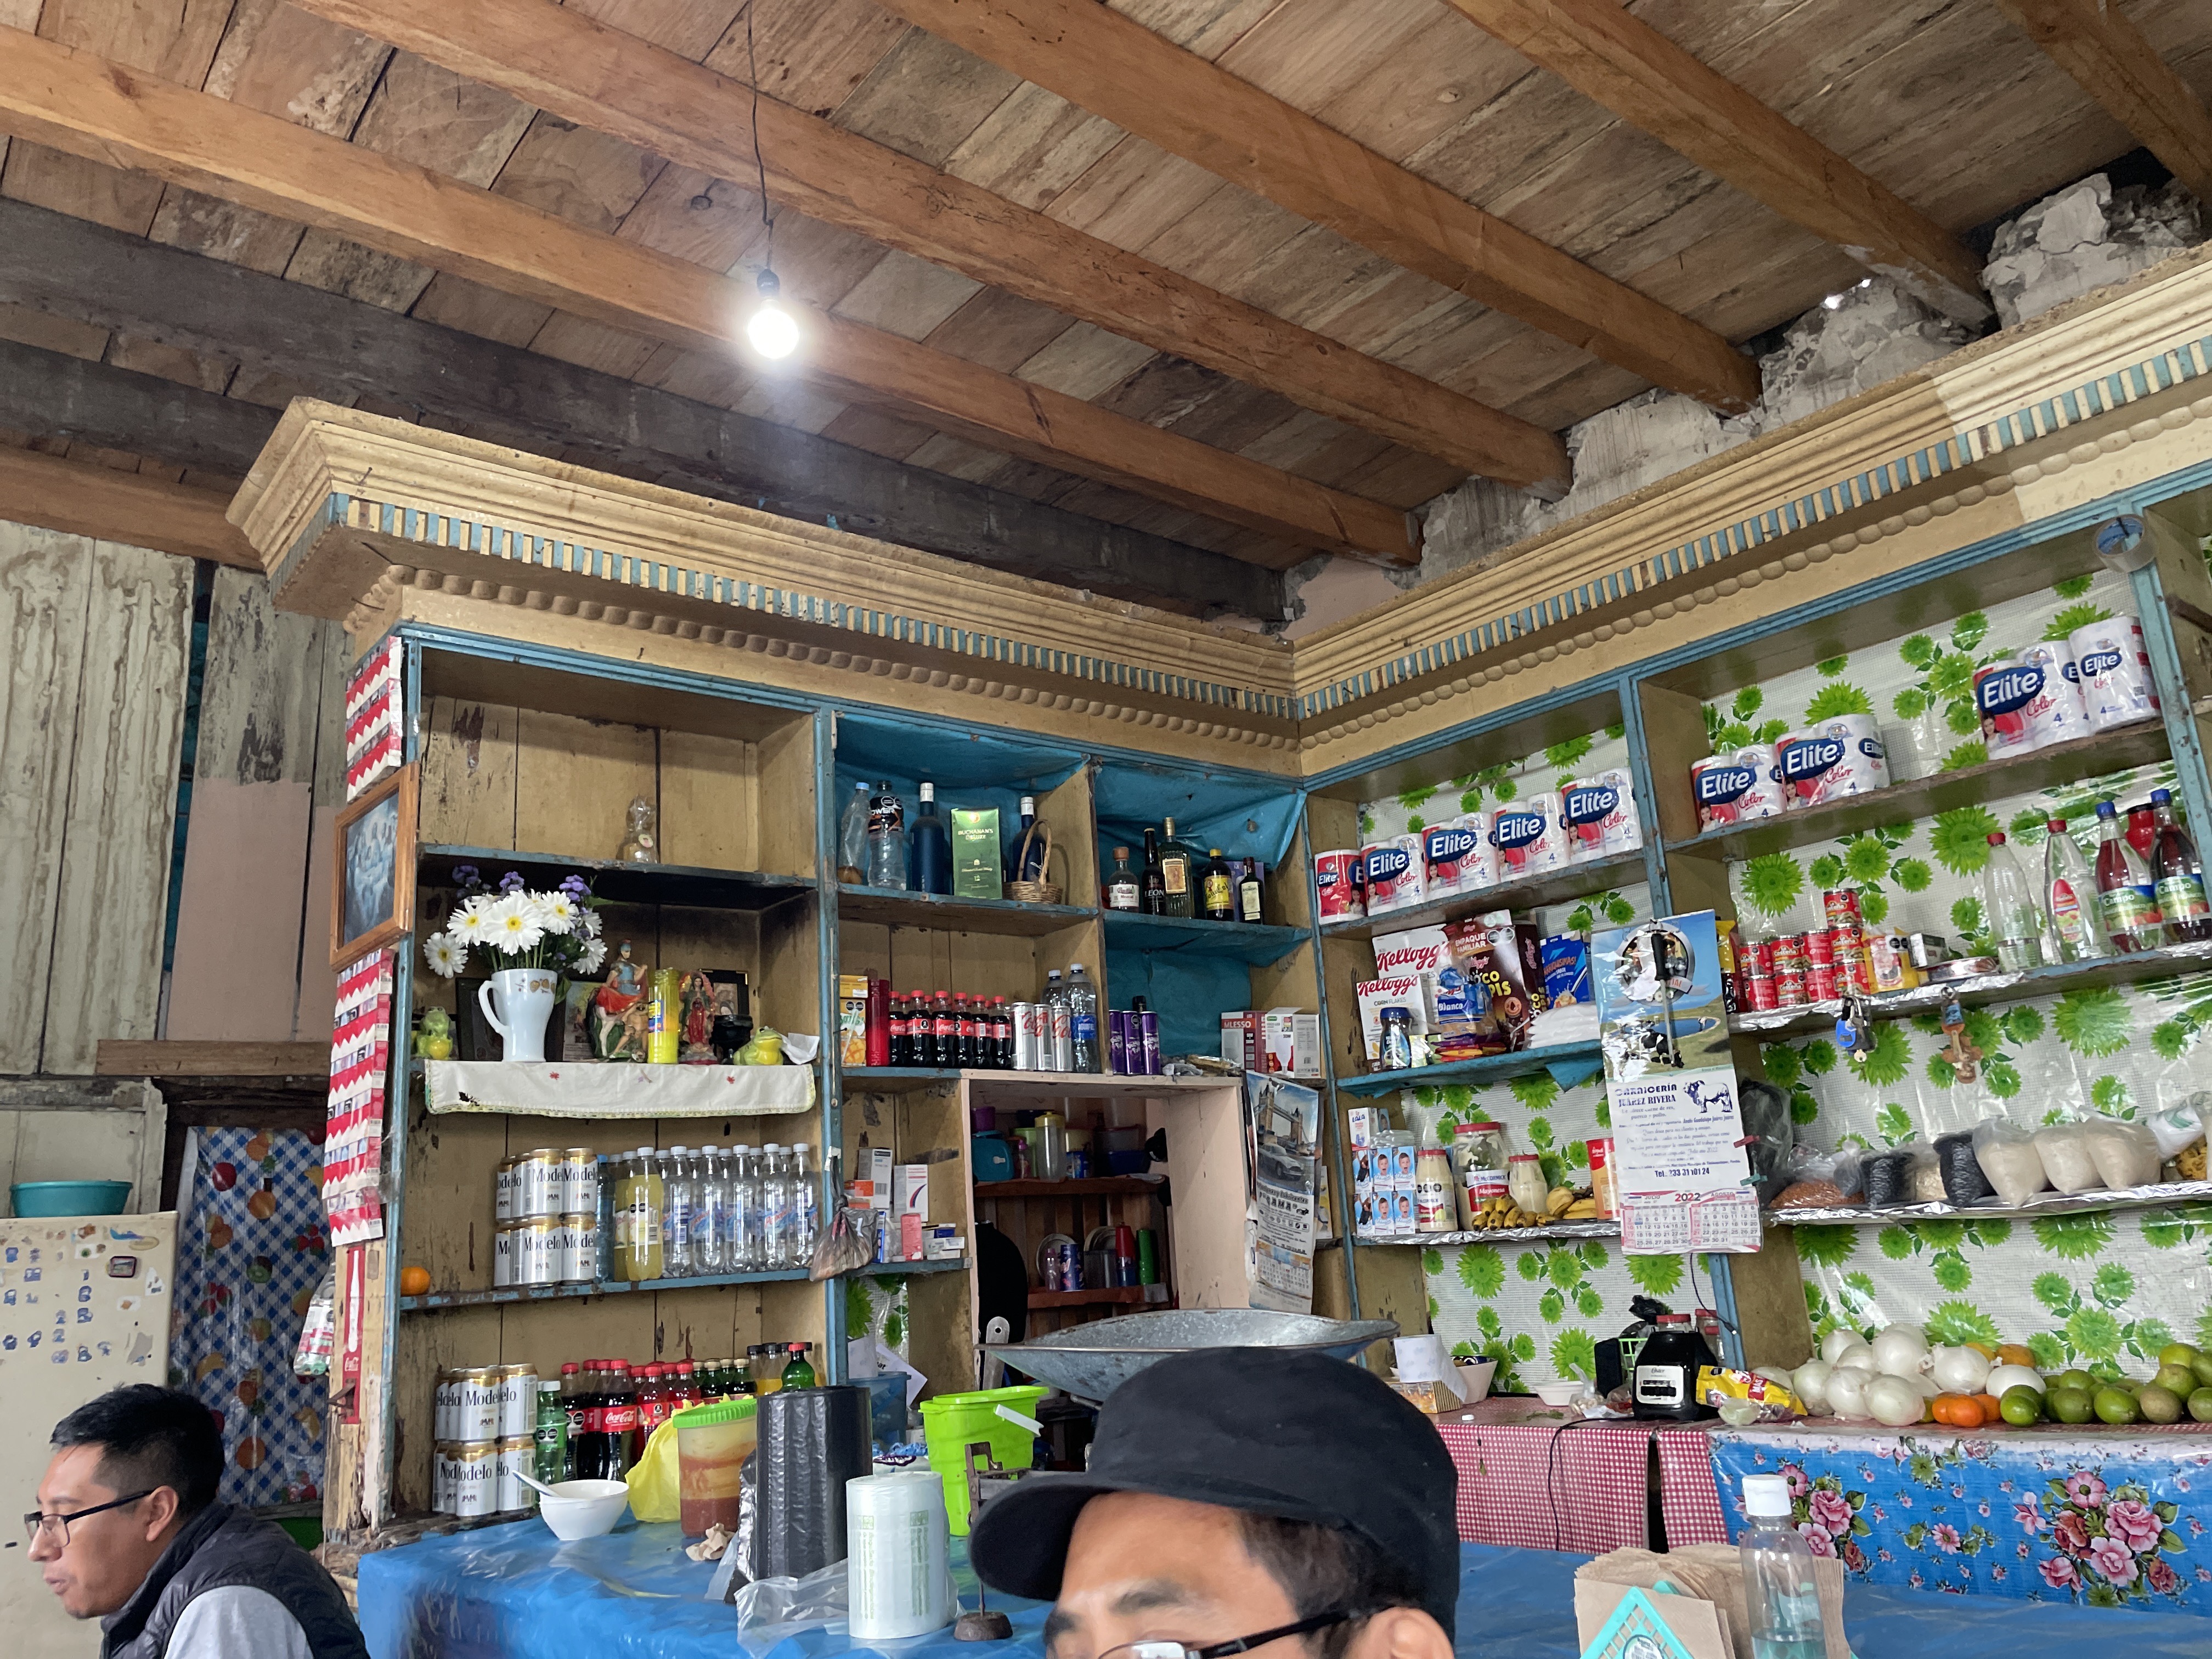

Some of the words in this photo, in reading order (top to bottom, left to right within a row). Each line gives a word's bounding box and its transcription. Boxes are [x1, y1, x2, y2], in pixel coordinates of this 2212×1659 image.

[2085, 655, 2118, 673] Elite
[1984, 672, 2036, 708] Elite
[2027, 695, 2057, 716] Color
[1786, 743, 1837, 774] Elite
[1825, 765, 1853, 783] Color
[1701, 770, 1750, 799] Elite
[1570, 792, 1613, 819] Elite
[1737, 792, 1765, 809] Color
[1603, 811, 1628, 828] Color
[958, 828, 994, 836] BUCHANAN'S
[1499, 817, 1540, 843] Elite
[1431, 833, 1472, 857] Elite
[1530, 837, 1553, 854] Color
[1369, 853, 1406, 876] Elite
[1460, 853, 1483, 868] Color
[1549, 853, 1555, 861] 4
[1318, 873, 1338, 885] Elite
[1396, 871, 1418, 886] Color
[2159, 882, 2192, 894] Campo
[2103, 894, 2135, 906] Campo
[1455, 932, 1486, 947] EMPAQUE
[1457, 940, 1486, 953] FAMILIAR
[1358, 974, 1419, 997] Kellogg's
[1438, 1002, 1463, 1011] Blanco
[1648, 1094, 1677, 1104] RIVERA
[1675, 1192, 1701, 1202] 2022
[524, 1235, 561, 1252] Modelo
[605, 1410, 635, 1424] Coca-Cola
